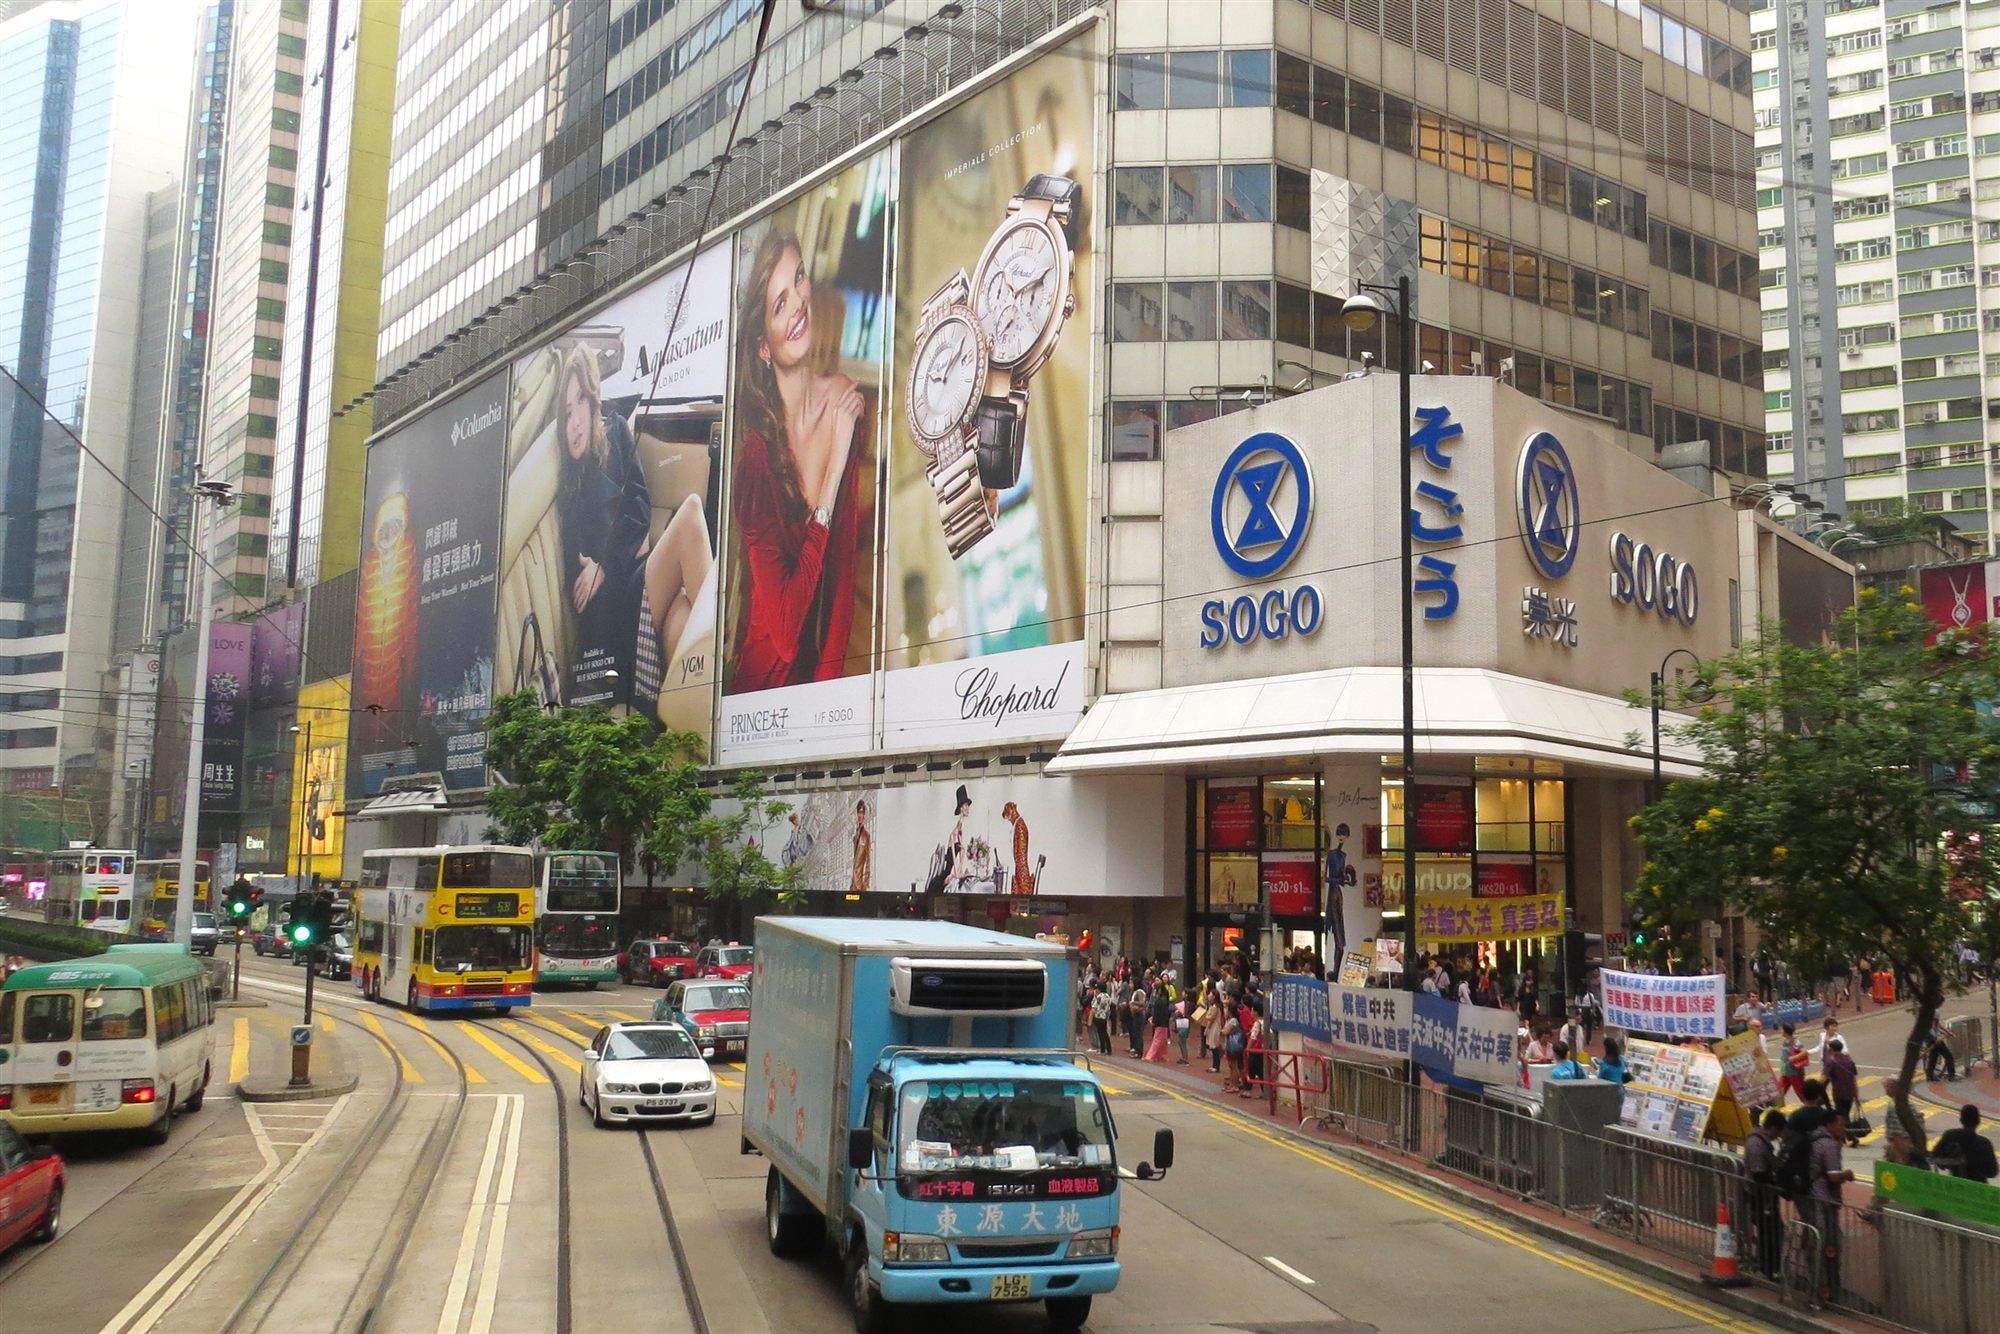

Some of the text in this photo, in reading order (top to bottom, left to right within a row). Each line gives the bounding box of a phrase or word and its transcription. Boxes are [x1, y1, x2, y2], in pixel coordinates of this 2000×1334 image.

[944, 123, 1042, 181] IMPERIALE COLLECTION
[631, 319, 723, 385] Aquascutum
[658, 366, 691, 389] LONDON
[460, 402, 502, 440] Columbia
[1410, 406, 1464, 622] そごう
[1609, 532, 1698, 627] SOGO
[1200, 585, 1325, 649] SOGO
[1522, 586, 1578, 648] 崇光
[955, 659, 1071, 728] Chopard
[828, 708, 854, 722] SOGO
[203, 763, 235, 781] 周生生
[1419, 900, 1559, 936] 法輪大法 真善忍
[1342, 992, 1395, 1021] 解體中共
[919, 1180, 975, 1197] 紅十字會
[988, 1183, 1036, 1195] ISUZU
[1048, 1178, 1099, 1193] 血液製品
[935, 1202, 1085, 1237] 東源大地
[994, 1286, 1029, 1298] 7525
[1004, 1275, 1021, 1286] LG
